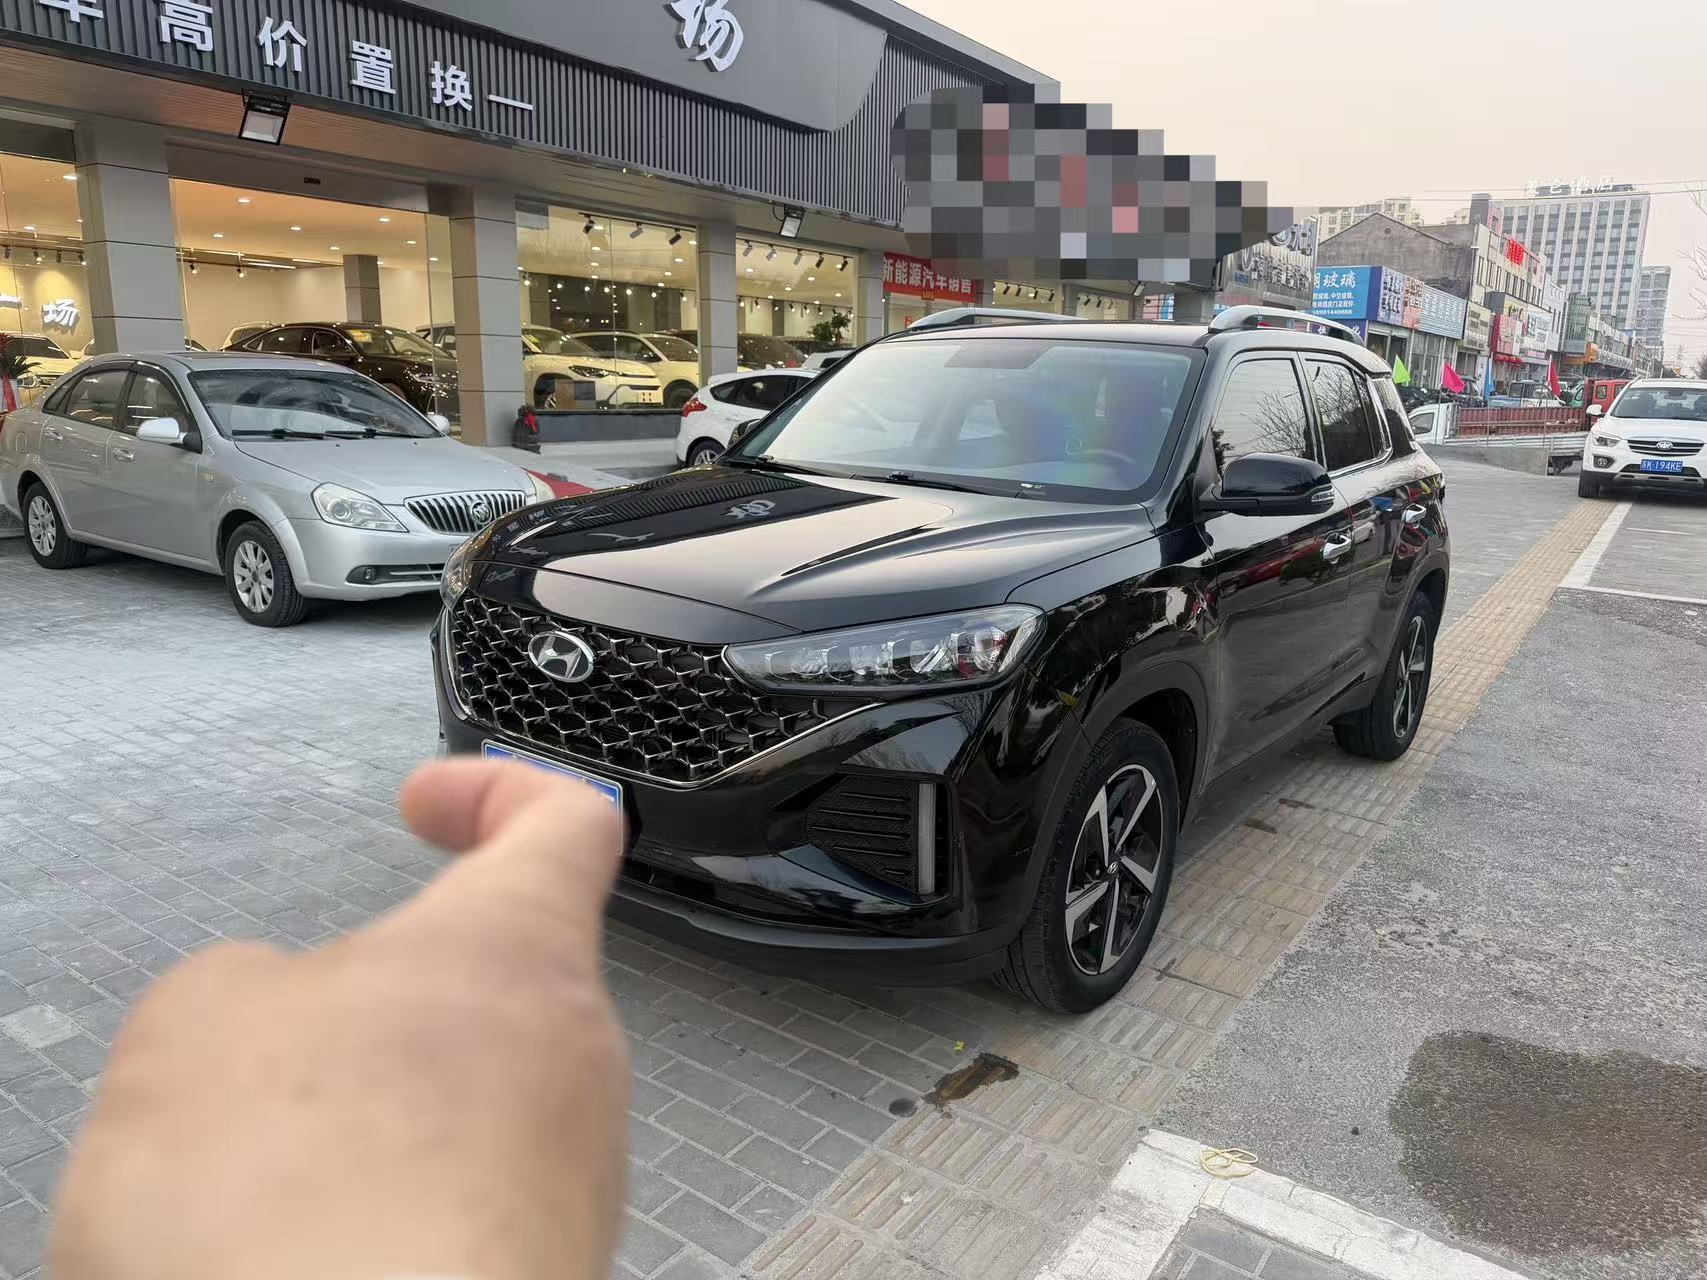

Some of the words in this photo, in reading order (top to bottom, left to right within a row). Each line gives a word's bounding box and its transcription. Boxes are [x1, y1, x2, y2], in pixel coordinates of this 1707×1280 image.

[882, 256, 972, 293] 新能源汽车销售
